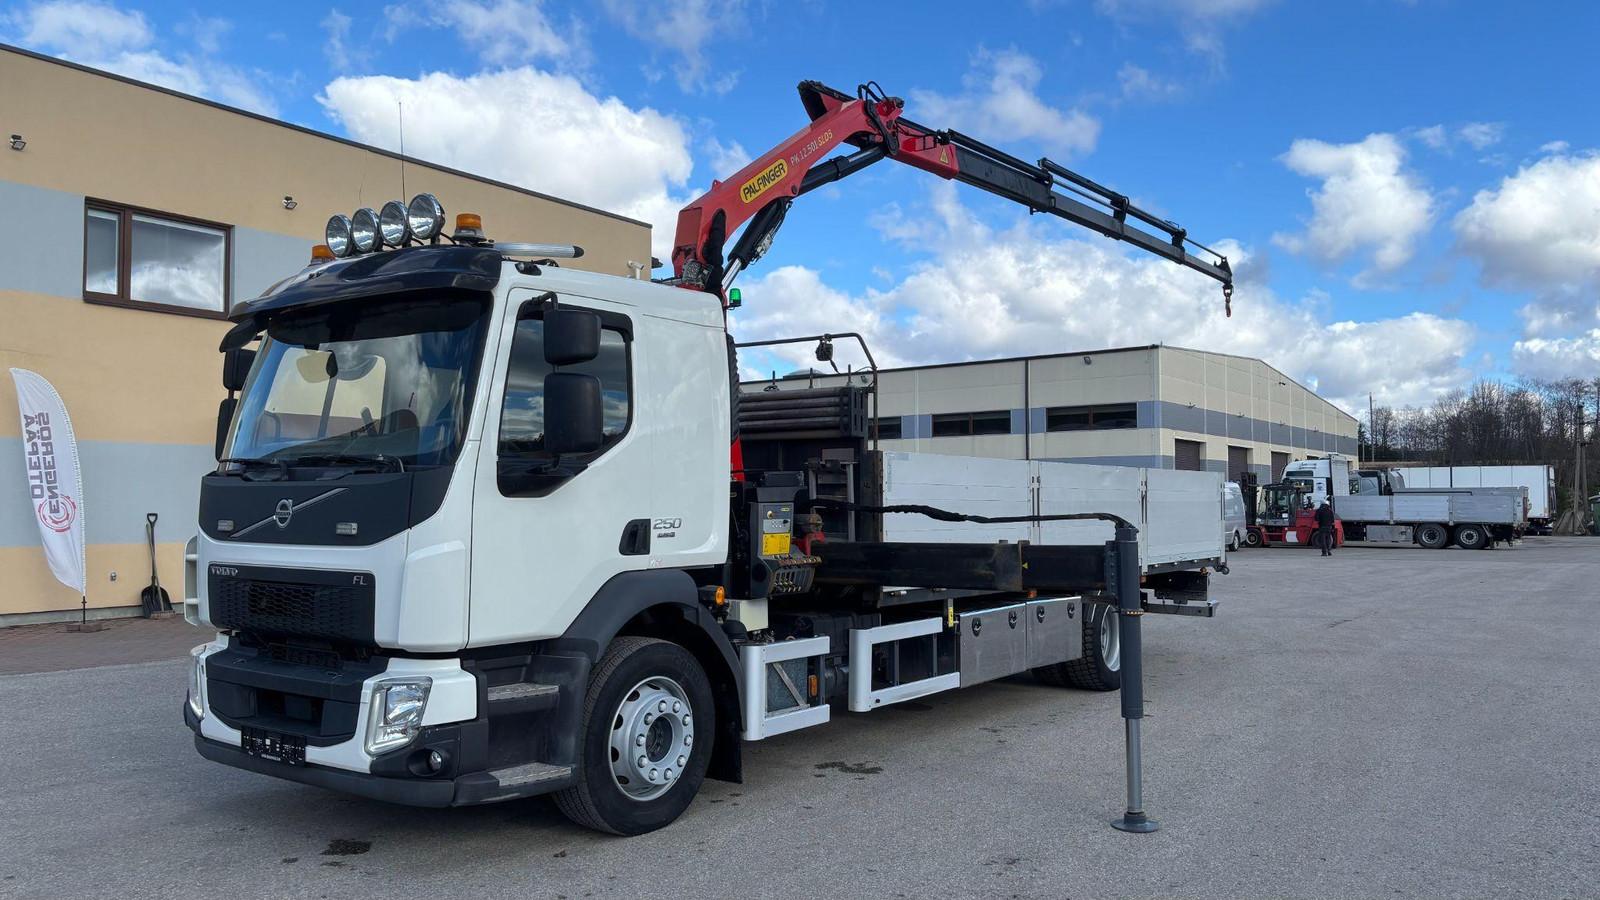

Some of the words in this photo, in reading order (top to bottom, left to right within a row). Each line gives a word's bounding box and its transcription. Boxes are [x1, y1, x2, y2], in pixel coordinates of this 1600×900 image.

[790, 153, 800, 166] PK
[799, 140, 819, 160] 12.501
[743, 162, 785, 201] PALFINGER
[653, 517, 682, 529] 250
[211, 566, 238, 576] VOLVO
[352, 575, 368, 585] FL
